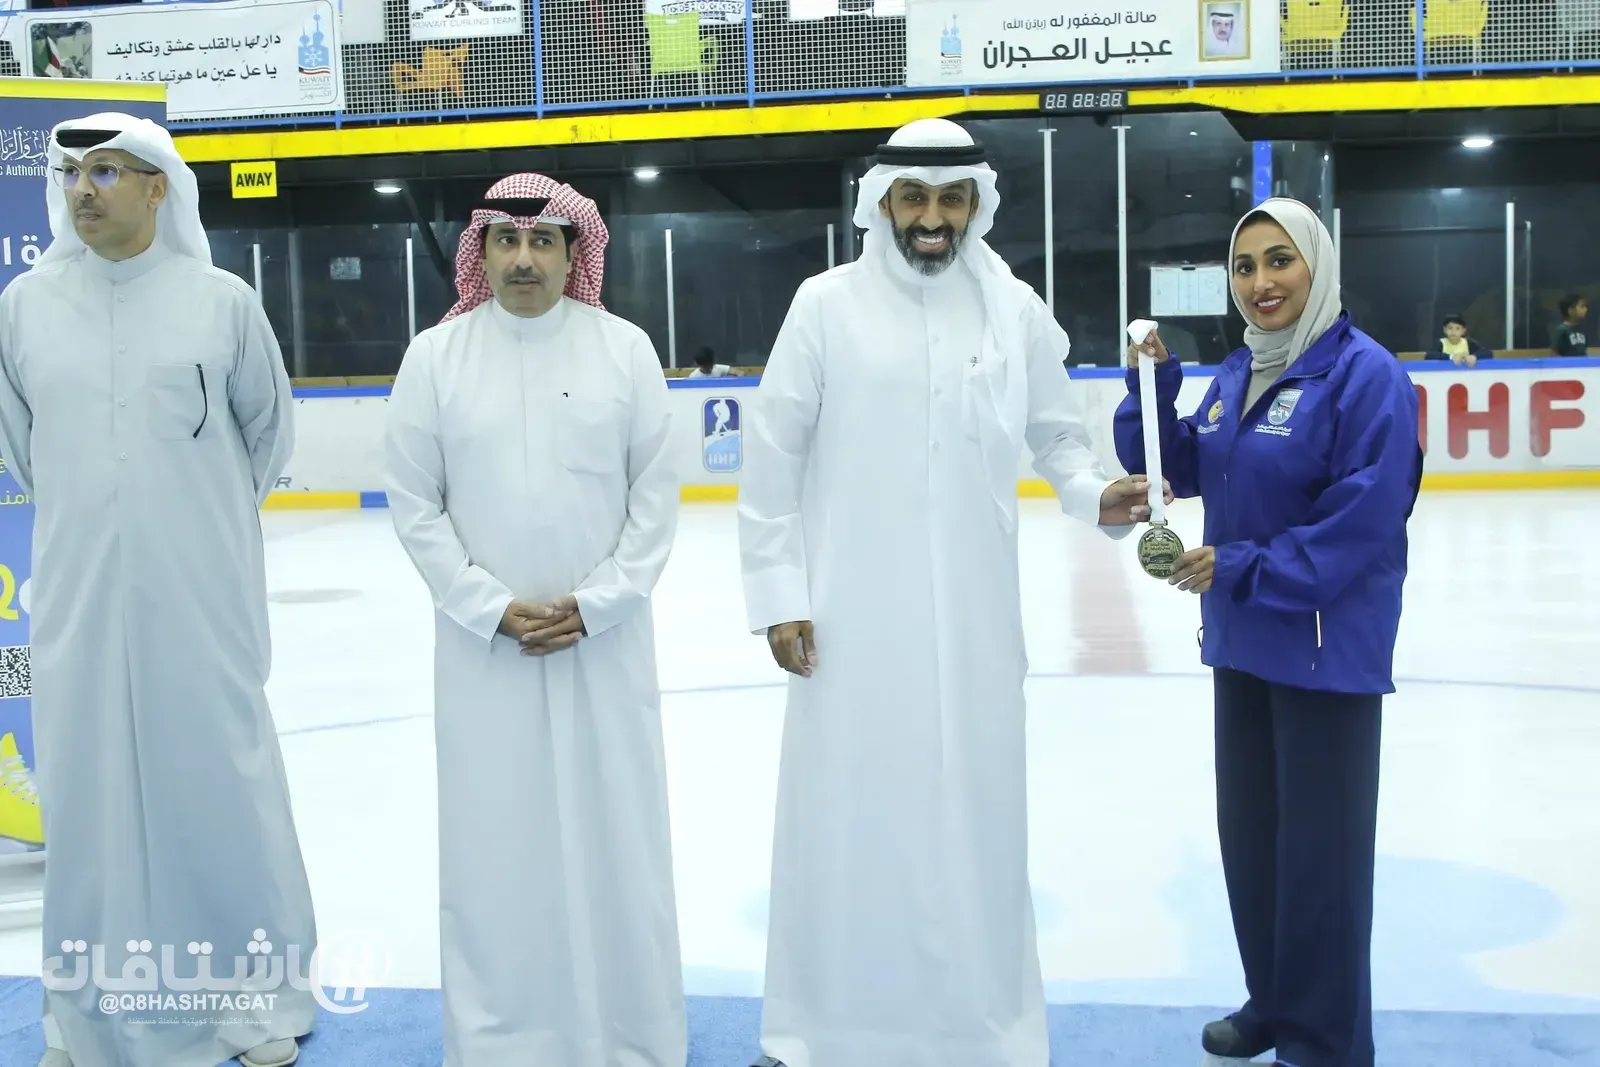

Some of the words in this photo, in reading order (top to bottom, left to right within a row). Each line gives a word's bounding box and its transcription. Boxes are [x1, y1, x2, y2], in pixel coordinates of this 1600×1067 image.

[412, 19, 447, 28] KUWAIT
[492, 16, 517, 25] TEAM
[1050, 15, 1064, 27] له
[1066, 12, 1121, 29] المغفور
[1125, 11, 1157, 24] صالة
[106, 41, 160, 58] وتكاليف
[162, 40, 195, 56] عشق
[198, 37, 241, 54] بالقلب
[983, 37, 1087, 69] العجران
[1094, 36, 1173, 64] عجيل
[196, 68, 208, 79] ما
[264, 63, 277, 79] يا
[299, 76, 331, 84] KUWAIT
[236, 171, 273, 188] AWAY
